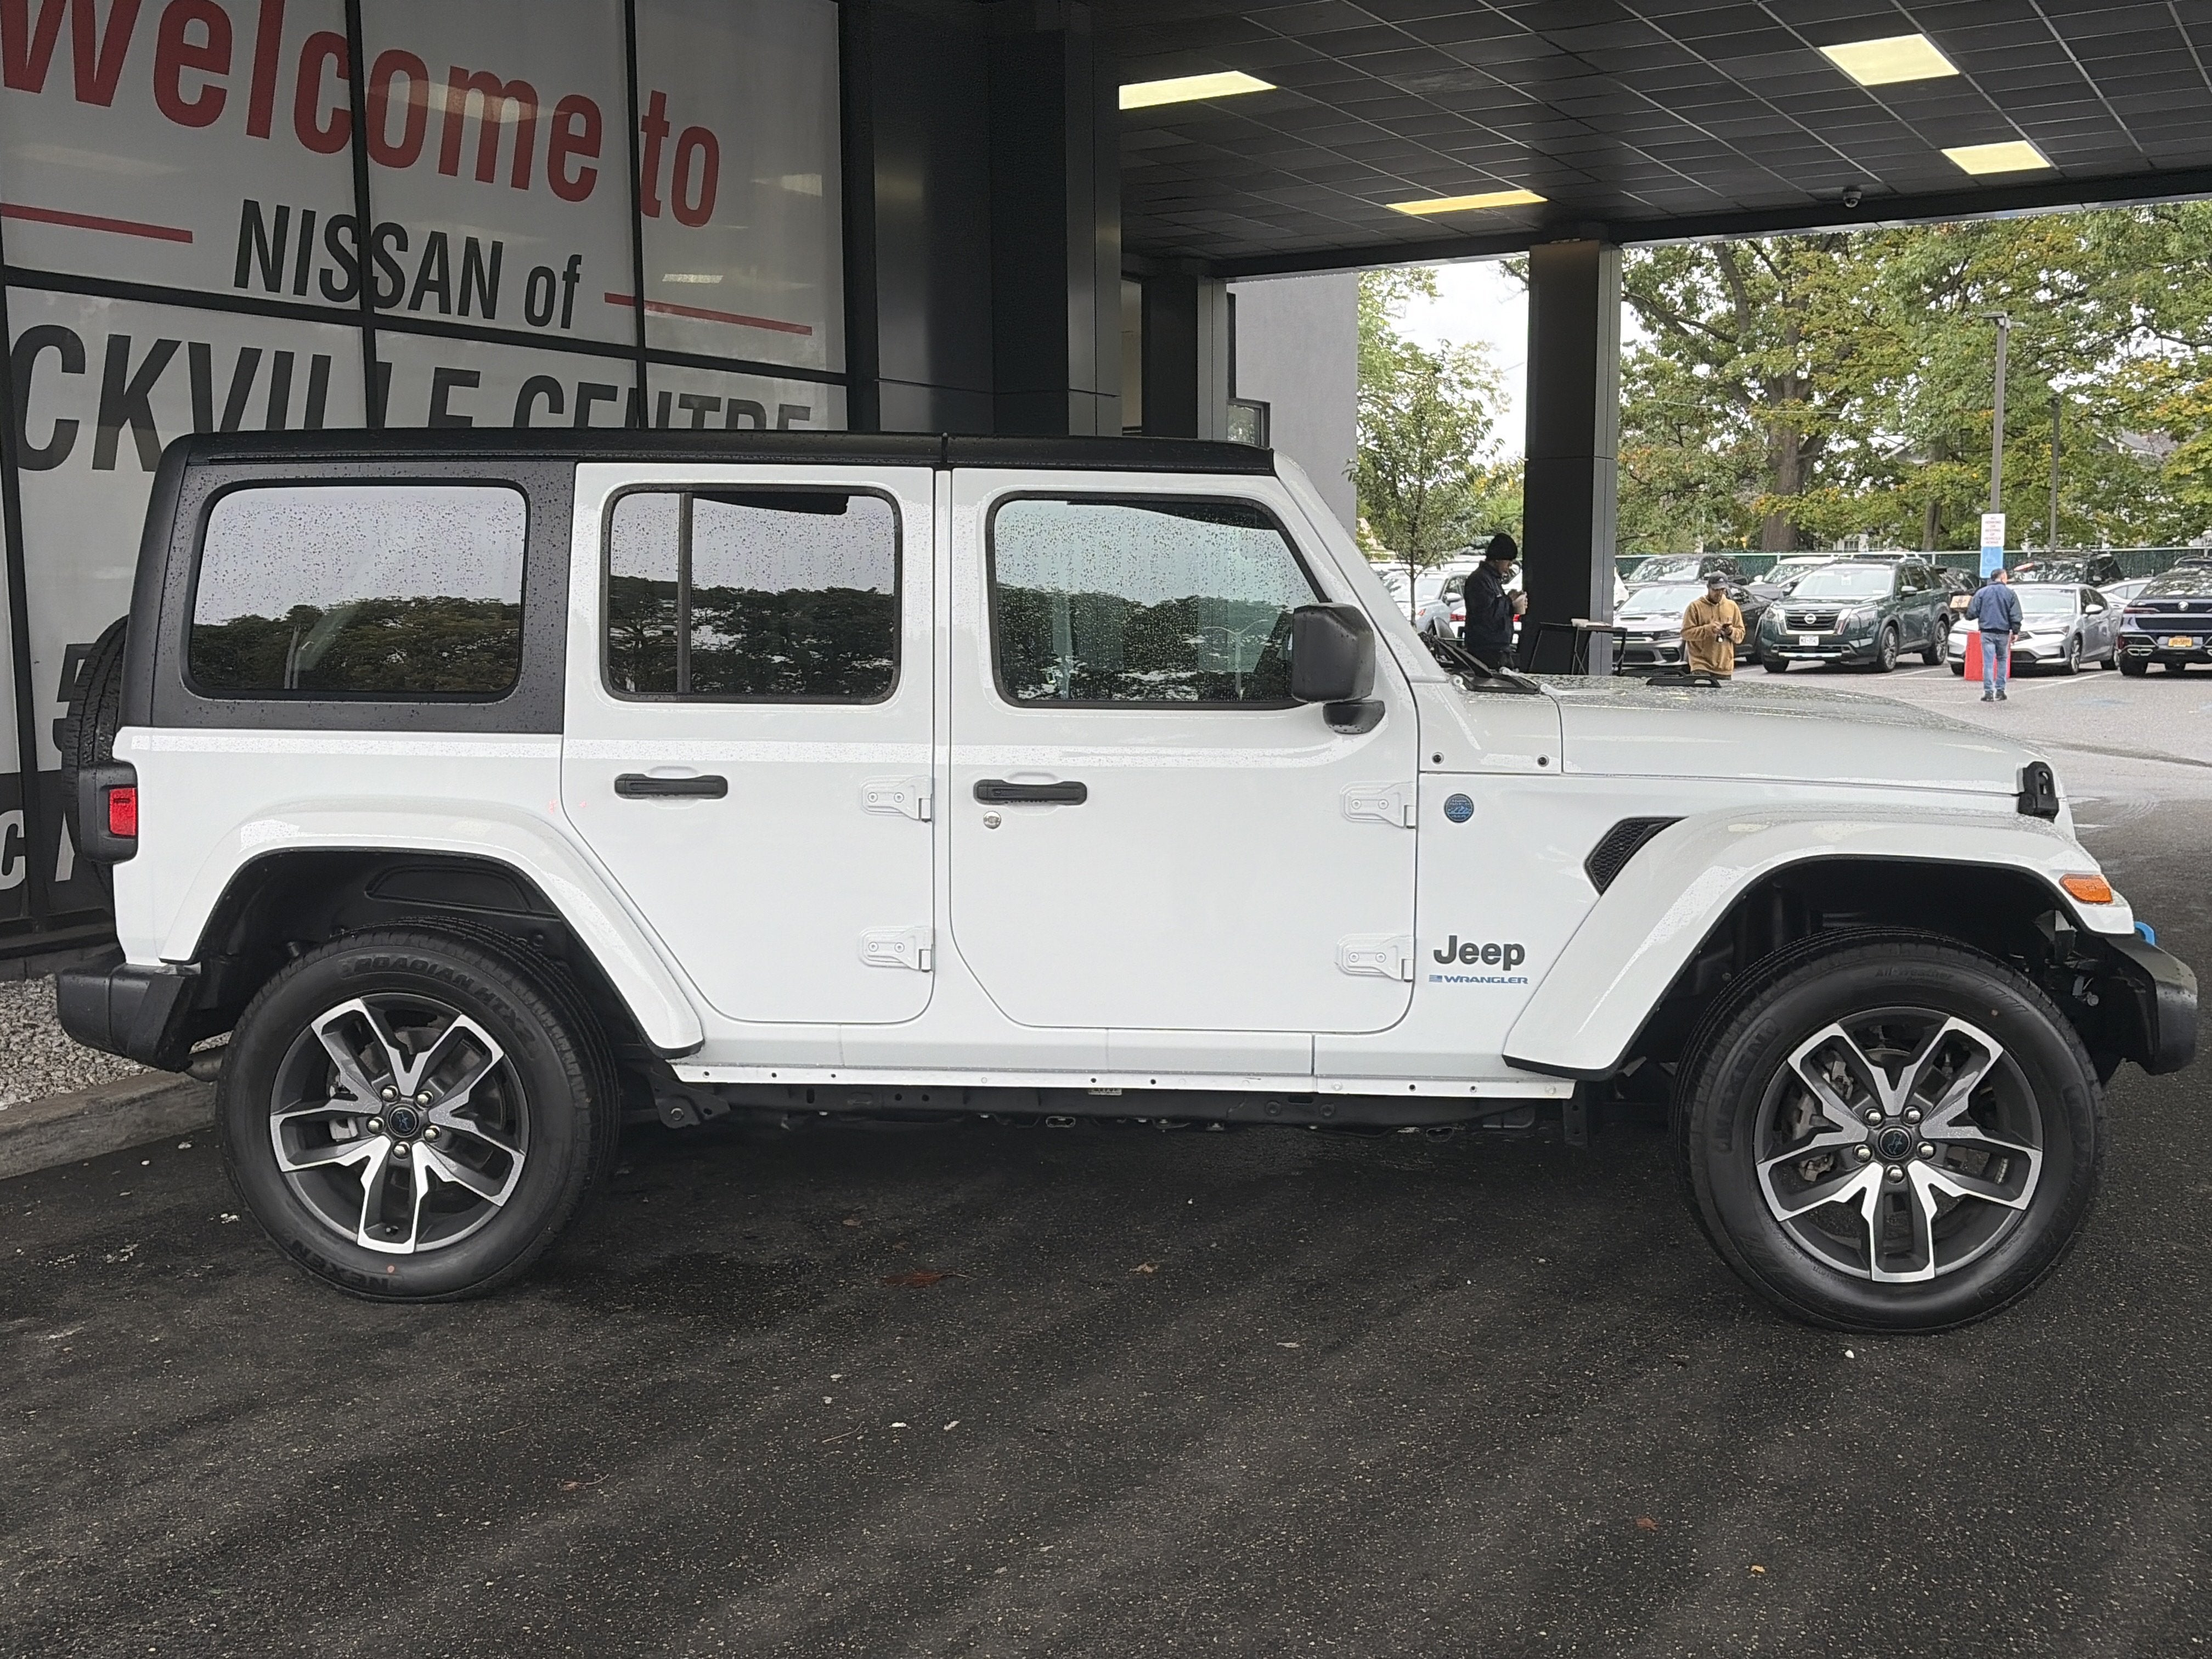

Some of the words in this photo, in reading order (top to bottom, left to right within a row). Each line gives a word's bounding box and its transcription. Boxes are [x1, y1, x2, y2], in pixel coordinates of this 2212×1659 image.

[0, 0, 602, 202] Welcome
[640, 90, 720, 227] to
[234, 199, 504, 320] NISSAN
[524, 254, 582, 329] of
[1433, 935, 1525, 971] Jeep
[1443, 975, 1528, 984] WRANGLER
